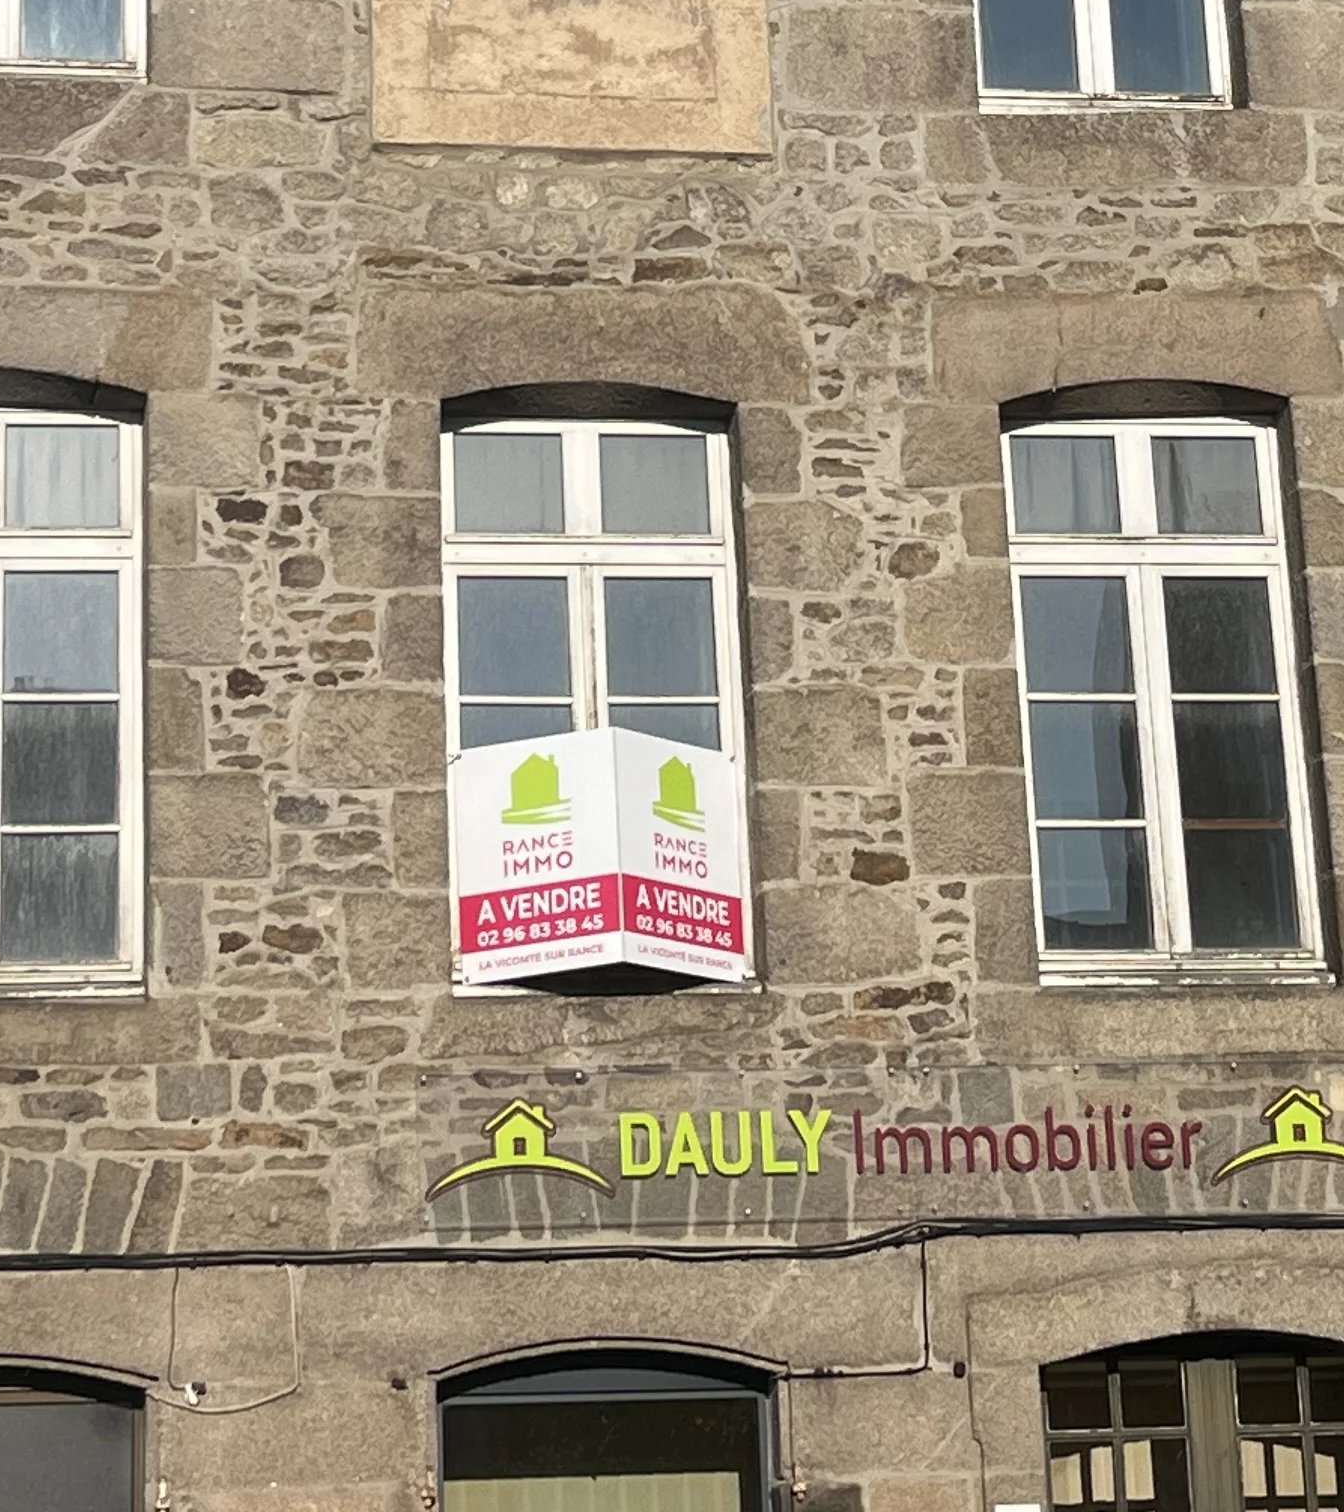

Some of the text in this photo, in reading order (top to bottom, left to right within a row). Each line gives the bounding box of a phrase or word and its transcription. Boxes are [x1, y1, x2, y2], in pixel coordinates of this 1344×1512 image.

[503, 830, 574, 856] RANCE
[654, 832, 708, 858] RANCE
[504, 850, 574, 878] IMMO
[655, 851, 708, 879] IMMO
[477, 882, 602, 926] A VENDRE
[636, 884, 731, 926] A VENDRE
[477, 913, 604, 948] 02 96 83 38 45
[636, 914, 733, 948] 02 96 83 38 45
[618, 1103, 1204, 1178] DAULY Immobilier
